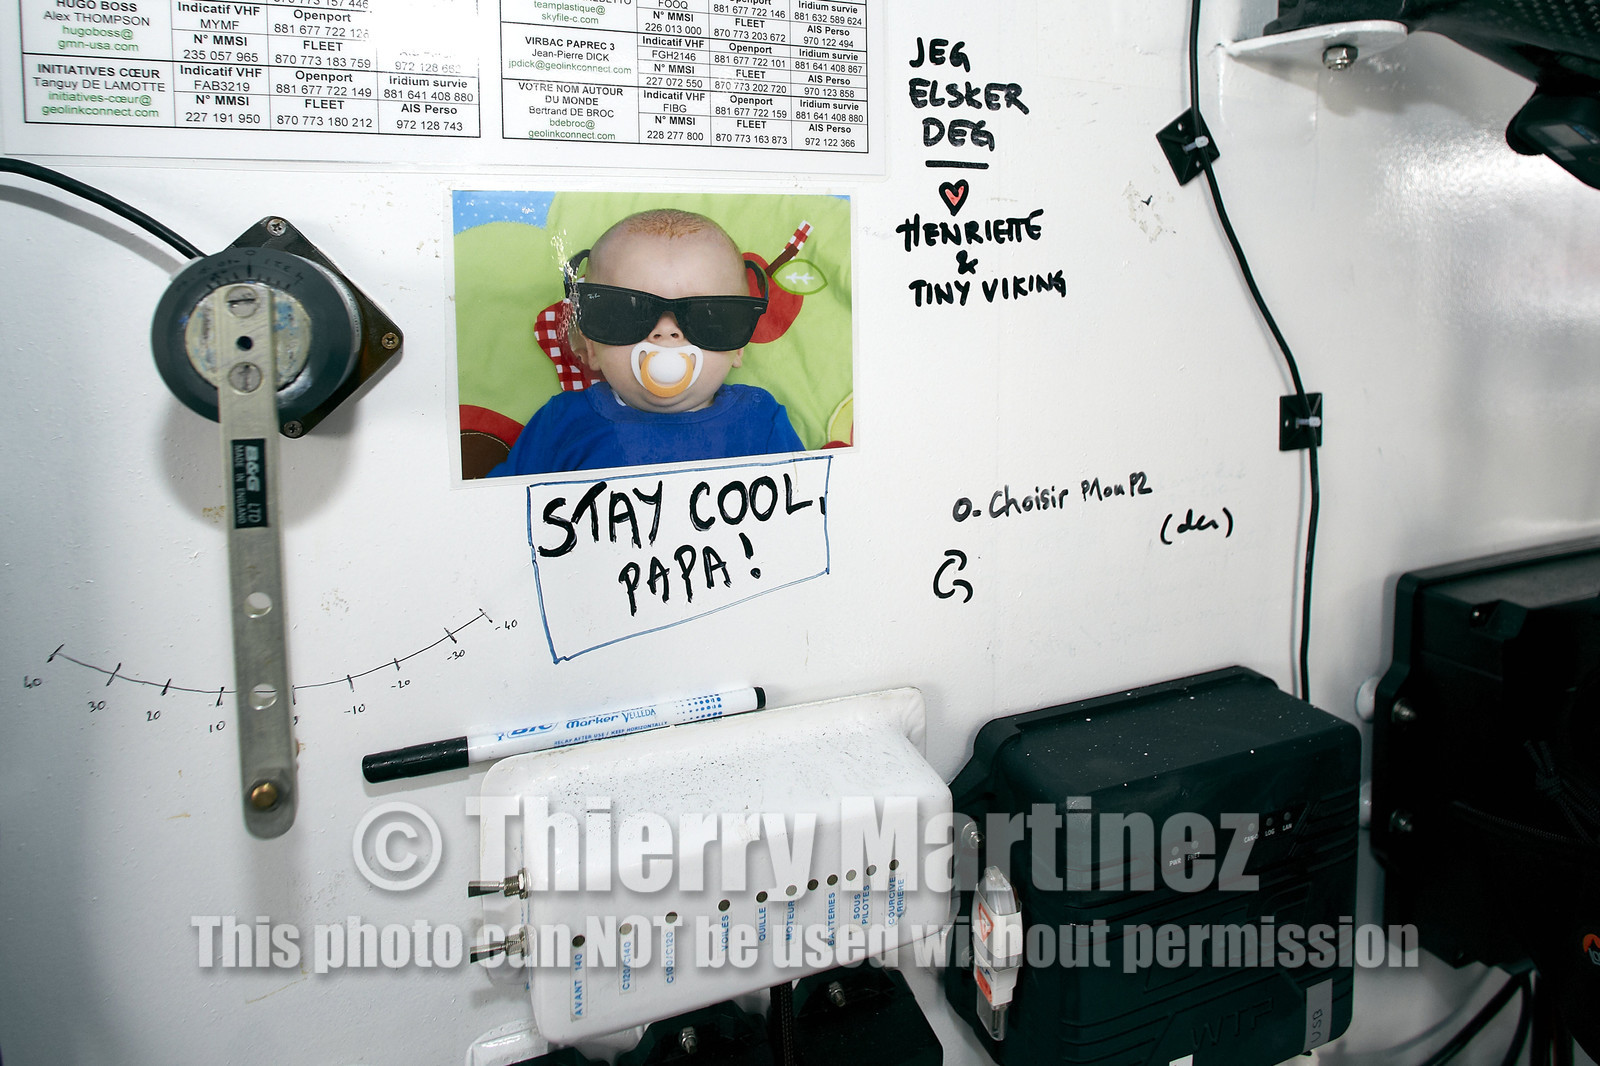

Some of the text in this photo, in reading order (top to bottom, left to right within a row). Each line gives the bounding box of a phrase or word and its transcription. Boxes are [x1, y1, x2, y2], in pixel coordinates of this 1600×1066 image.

[56, 0, 137, 12] HUGO BOSS
[534, 0, 605, 15] teamplastique@
[43, 11, 150, 26] Alex THOMPSON
[541, 12, 599, 24] skyfile-c.com
[62, 25, 134, 40] hugoboss@
[58, 40, 139, 51] gmn-usa.com
[525, 36, 615, 50] VIRBAC PAPREC 3
[532, 49, 609, 61] Jean-Pierre DICK
[909, 37, 970, 72] JEG
[37, 63, 160, 79] INITIATIVES CŒUR
[180, 65, 261, 79] Indicatif VHF
[509, 60, 632, 74] jpdick@geolinkconnect.com
[295, 70, 353, 83] Openport
[389, 75, 468, 88] Iridium survie
[32, 77, 166, 92] Tanguy DE LAMOTTE
[194, 81, 250, 92] FAB3219
[276, 84, 371, 97] 881 677 722 149
[518, 82, 623, 96] VOTRE NOM AUTOUR
[196, 95, 249, 106] N° MMSI
[384, 89, 473, 101] 881 641 408 880
[545, 96, 599, 106] DU MONDE
[643, 90, 705, 101] Indicatif VHF
[730, 94, 773, 106] Openport
[908, 78, 1030, 115] ELSKER
[42, 104, 159, 117] geolinkconnect.com
[305, 99, 344, 110] FLEET
[401, 104, 457, 114] AIS Perso
[663, 104, 687, 113] FIBG
[800, 99, 859, 111] Iridium survie
[186, 112, 260, 123] 227 191 950
[529, 106, 614, 118] Bertrand DE BROC
[715, 107, 787, 119] 881 677 722 159
[277, 115, 372, 128] 870 773 180 212
[397, 120, 463, 131] 972 128 743
[550, 118, 595, 130] bdebroc@
[655, 115, 696, 125] N° MMSI
[737, 120, 766, 129] FLEET
[528, 129, 615, 141] geolinkconnect.com
[809, 123, 851, 134] AIS Perso
[922, 117, 995, 151] DEG
[647, 131, 703, 141] 228 277 800
[716, 134, 787, 145] 870 773 163 873
[805, 138, 855, 148] 972 122 366
[895, 209, 1044, 252] HENRIETTE
[955, 250, 978, 274] &
[909, 270, 1067, 307] TINY VIKING
[234, 445, 246, 524] MADE IN ENGLAND
[245, 446, 261, 522] B&G LTD
[989, 484, 1068, 518] Choisir
[538, 481, 663, 557] STAY
[87, 700, 105, 713] 30
[146, 709, 161, 722] 20
[566, 714, 619, 729] Marker
[621, 708, 657, 723] VELLEDA
[209, 720, 226, 733] 10
[862, 884, 870, 925] PILOTES
[758, 907, 767, 941] QUILLE
[786, 900, 795, 941] MOTEUR
[721, 915, 729, 952] VOILES
[574, 954, 583, 1016] AVANT 140
[1312, 1009, 1323, 1043] USB
